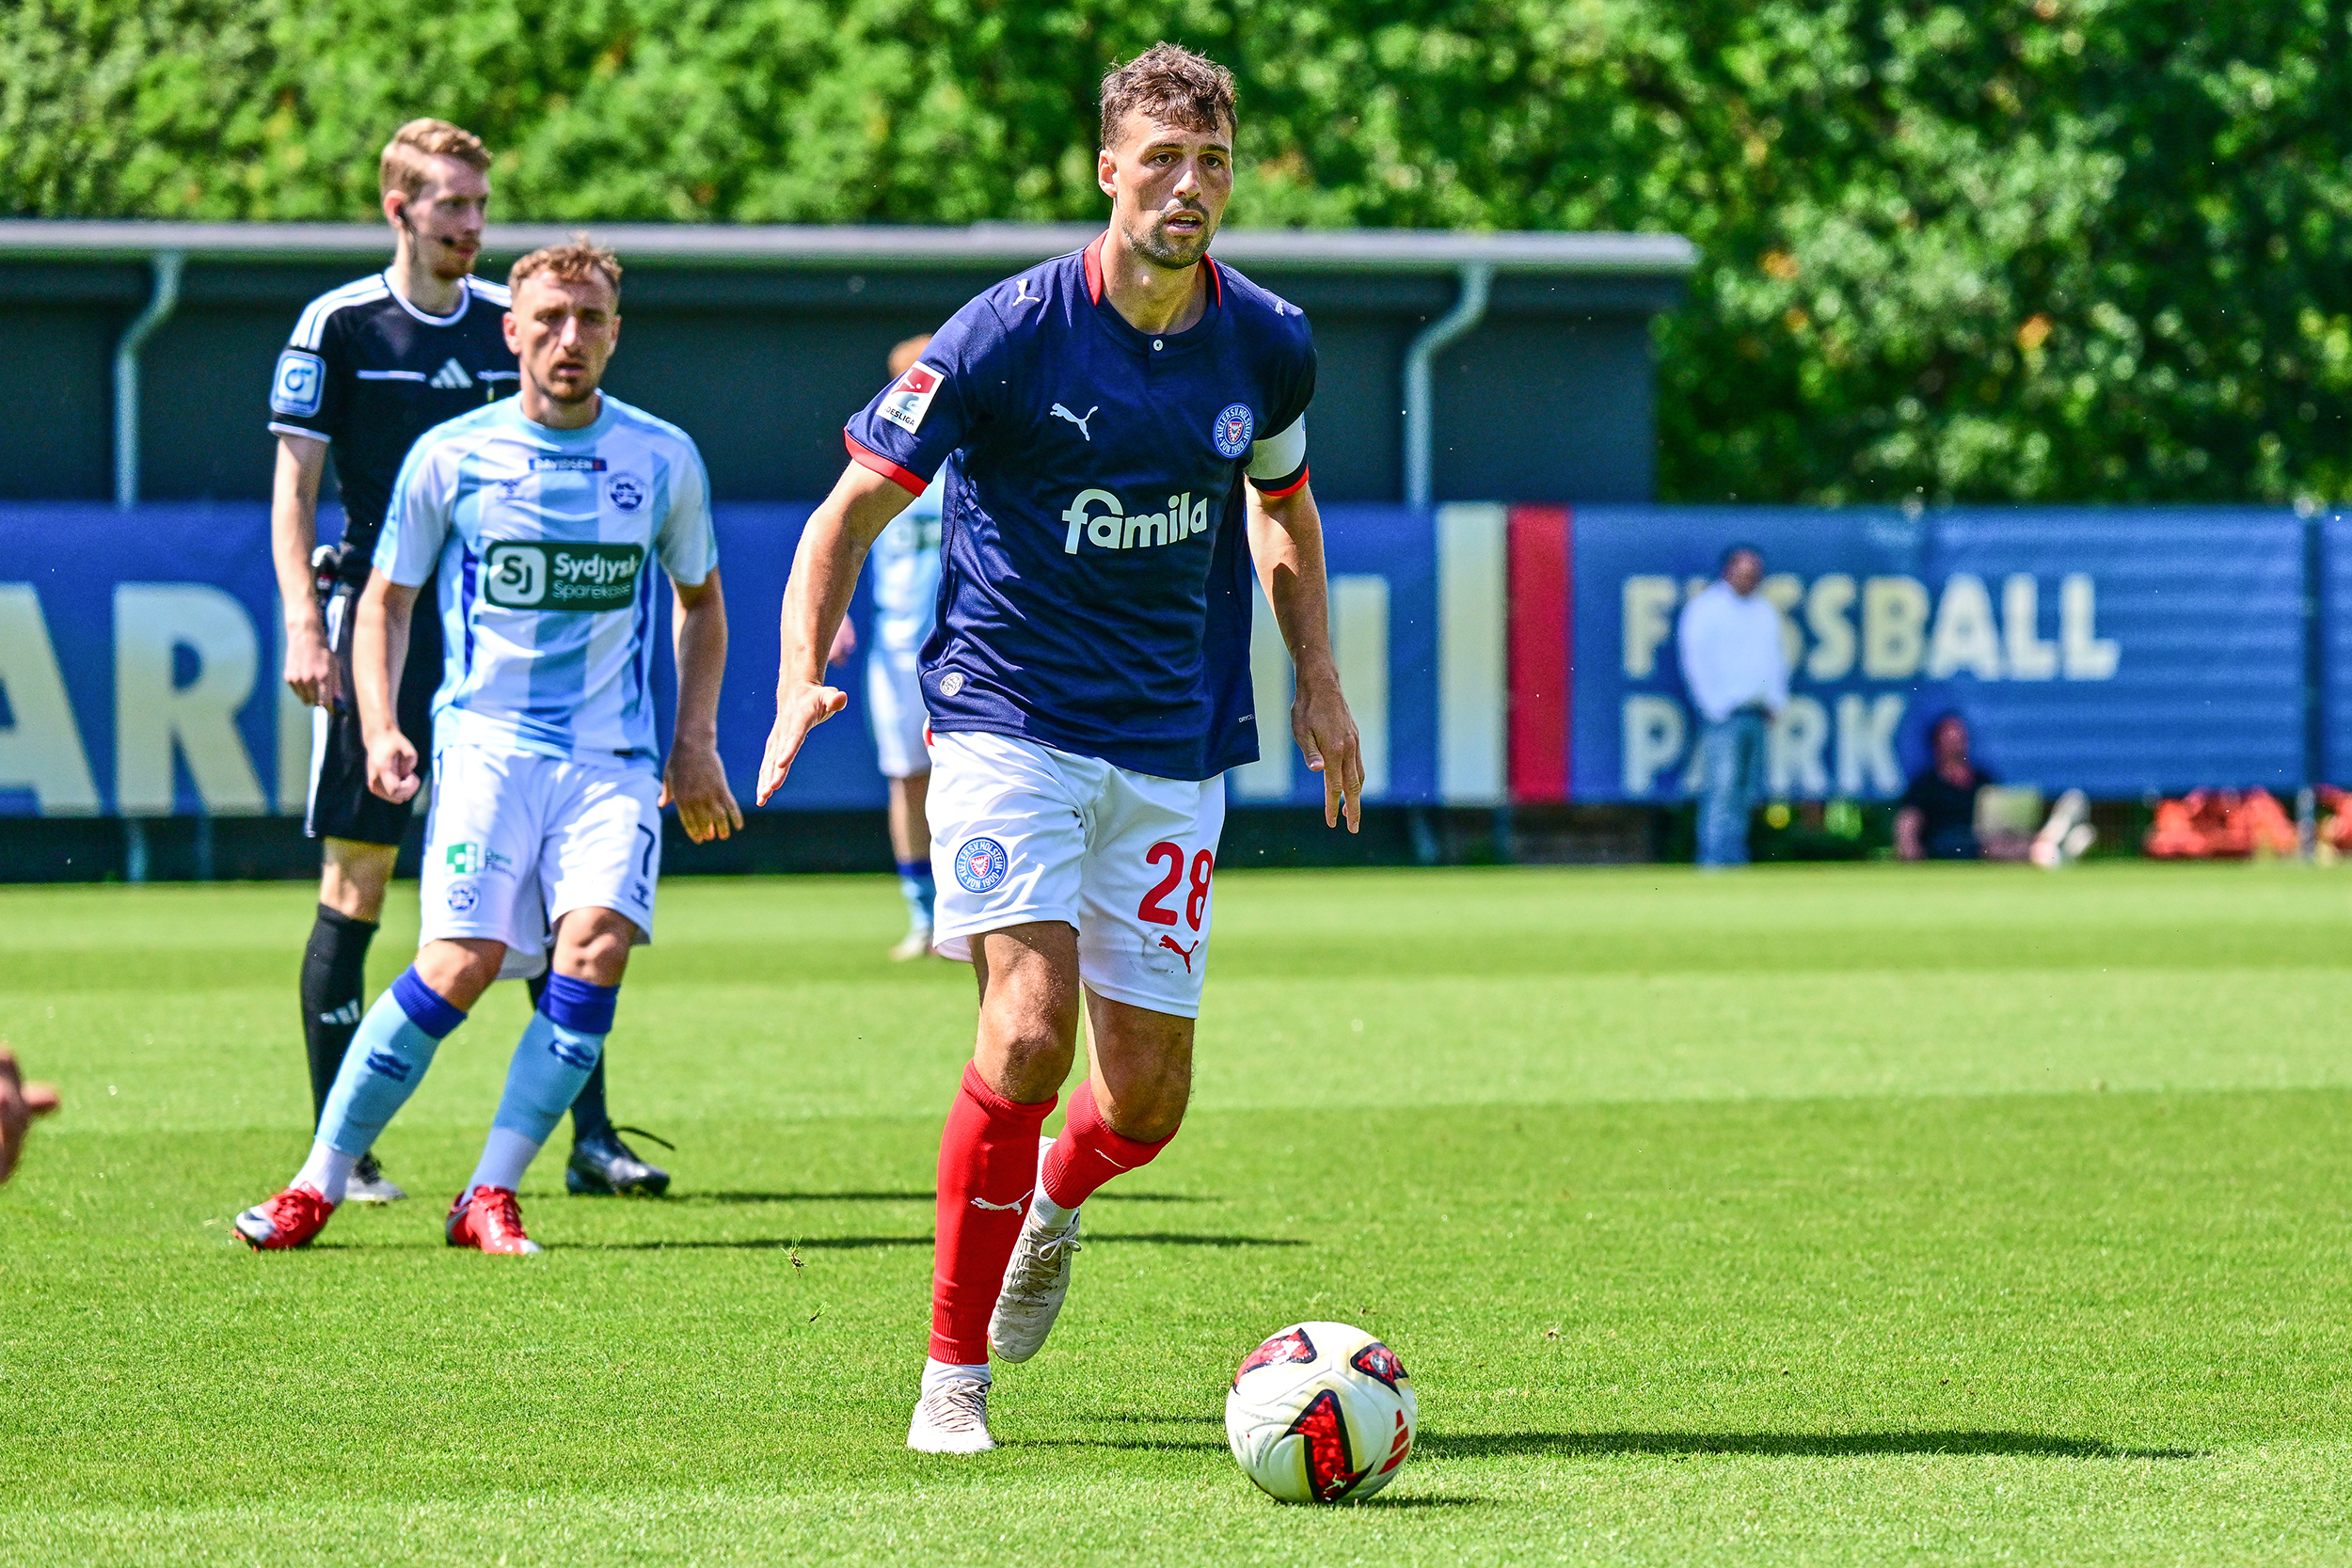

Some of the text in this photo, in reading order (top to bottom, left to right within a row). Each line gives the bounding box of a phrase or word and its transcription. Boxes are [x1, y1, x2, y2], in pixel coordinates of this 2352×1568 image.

[1217, 411, 1232, 438] KIELER
[1239, 408, 1251, 440] HOLSTEIN
[1220, 439, 1244, 454] VON 1900
[1061, 488, 1208, 555] famila
[501, 554, 532, 594] SJ
[1620, 573, 2121, 681] FSSBALL
[1621, 693, 1907, 796] PRK
[638, 823, 656, 879] 7
[958, 849, 972, 878] KIELER
[979, 841, 1004, 870] HOLSTEIN
[965, 871, 999, 889] VON 1900
[1137, 841, 1214, 932] 28
